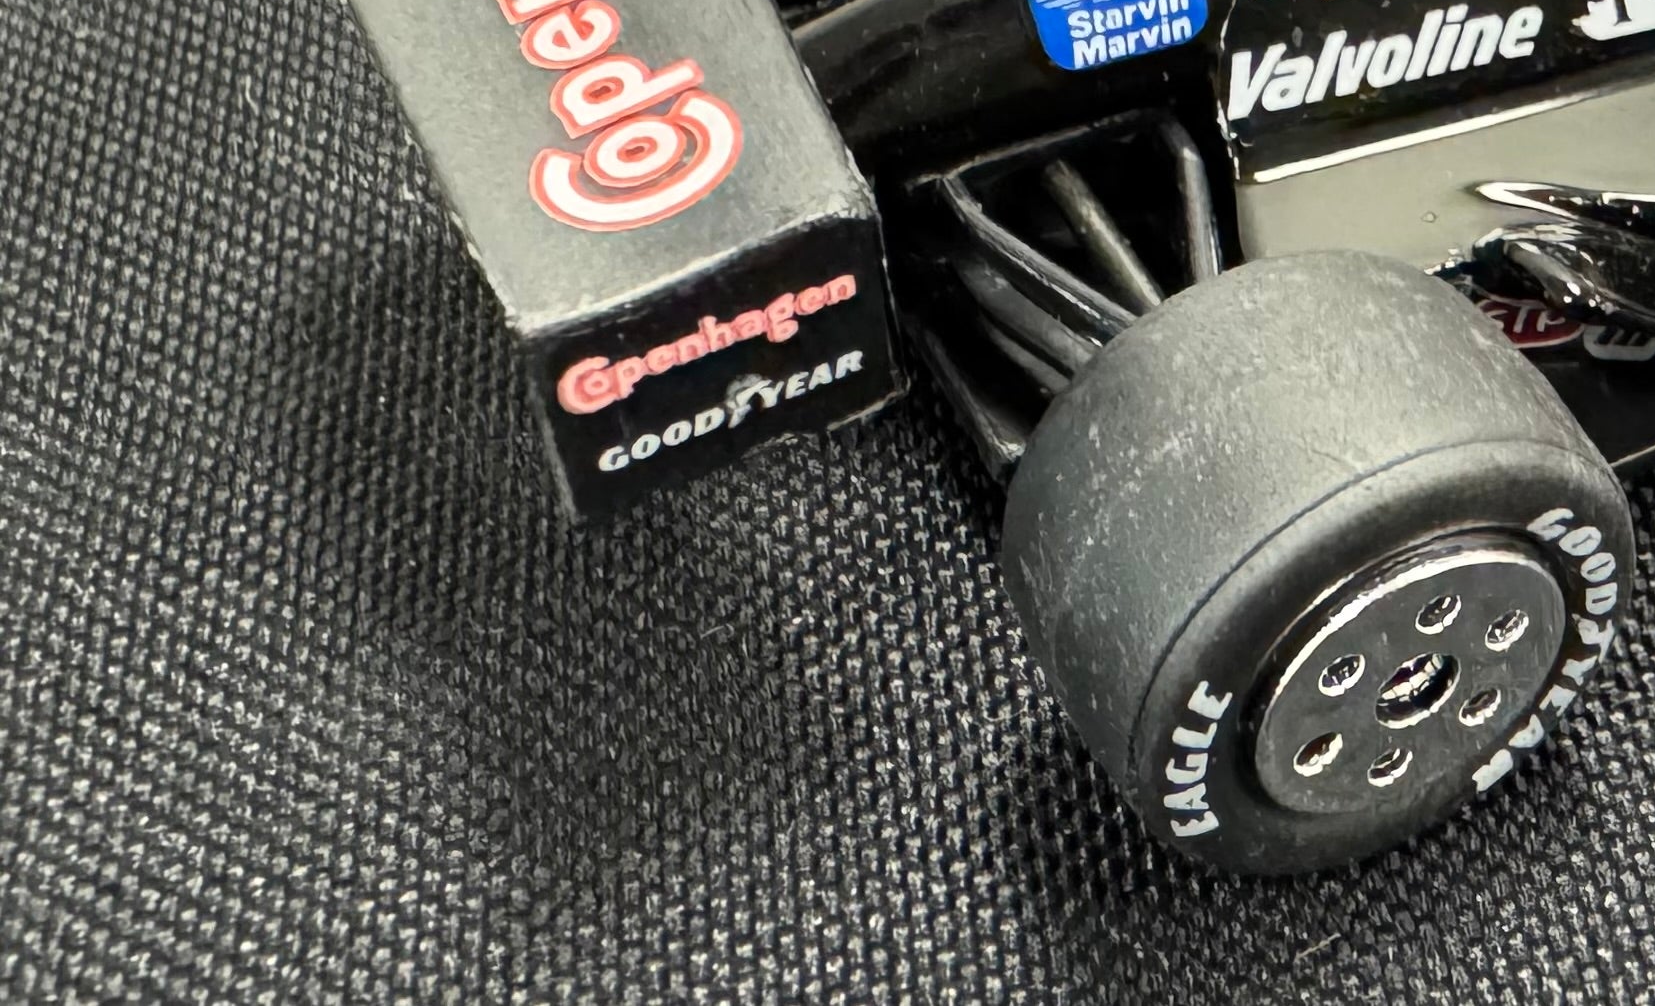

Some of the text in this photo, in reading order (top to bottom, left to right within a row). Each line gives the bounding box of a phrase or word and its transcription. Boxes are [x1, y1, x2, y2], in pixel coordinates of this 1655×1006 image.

[1072, 15, 1193, 70] Marvin
[1227, 3, 1544, 121] Valvoline
[556, 274, 857, 415] Copenhagen
[598, 349, 864, 472] GOODYEAR
[1163, 680, 1234, 838] EAGLE
